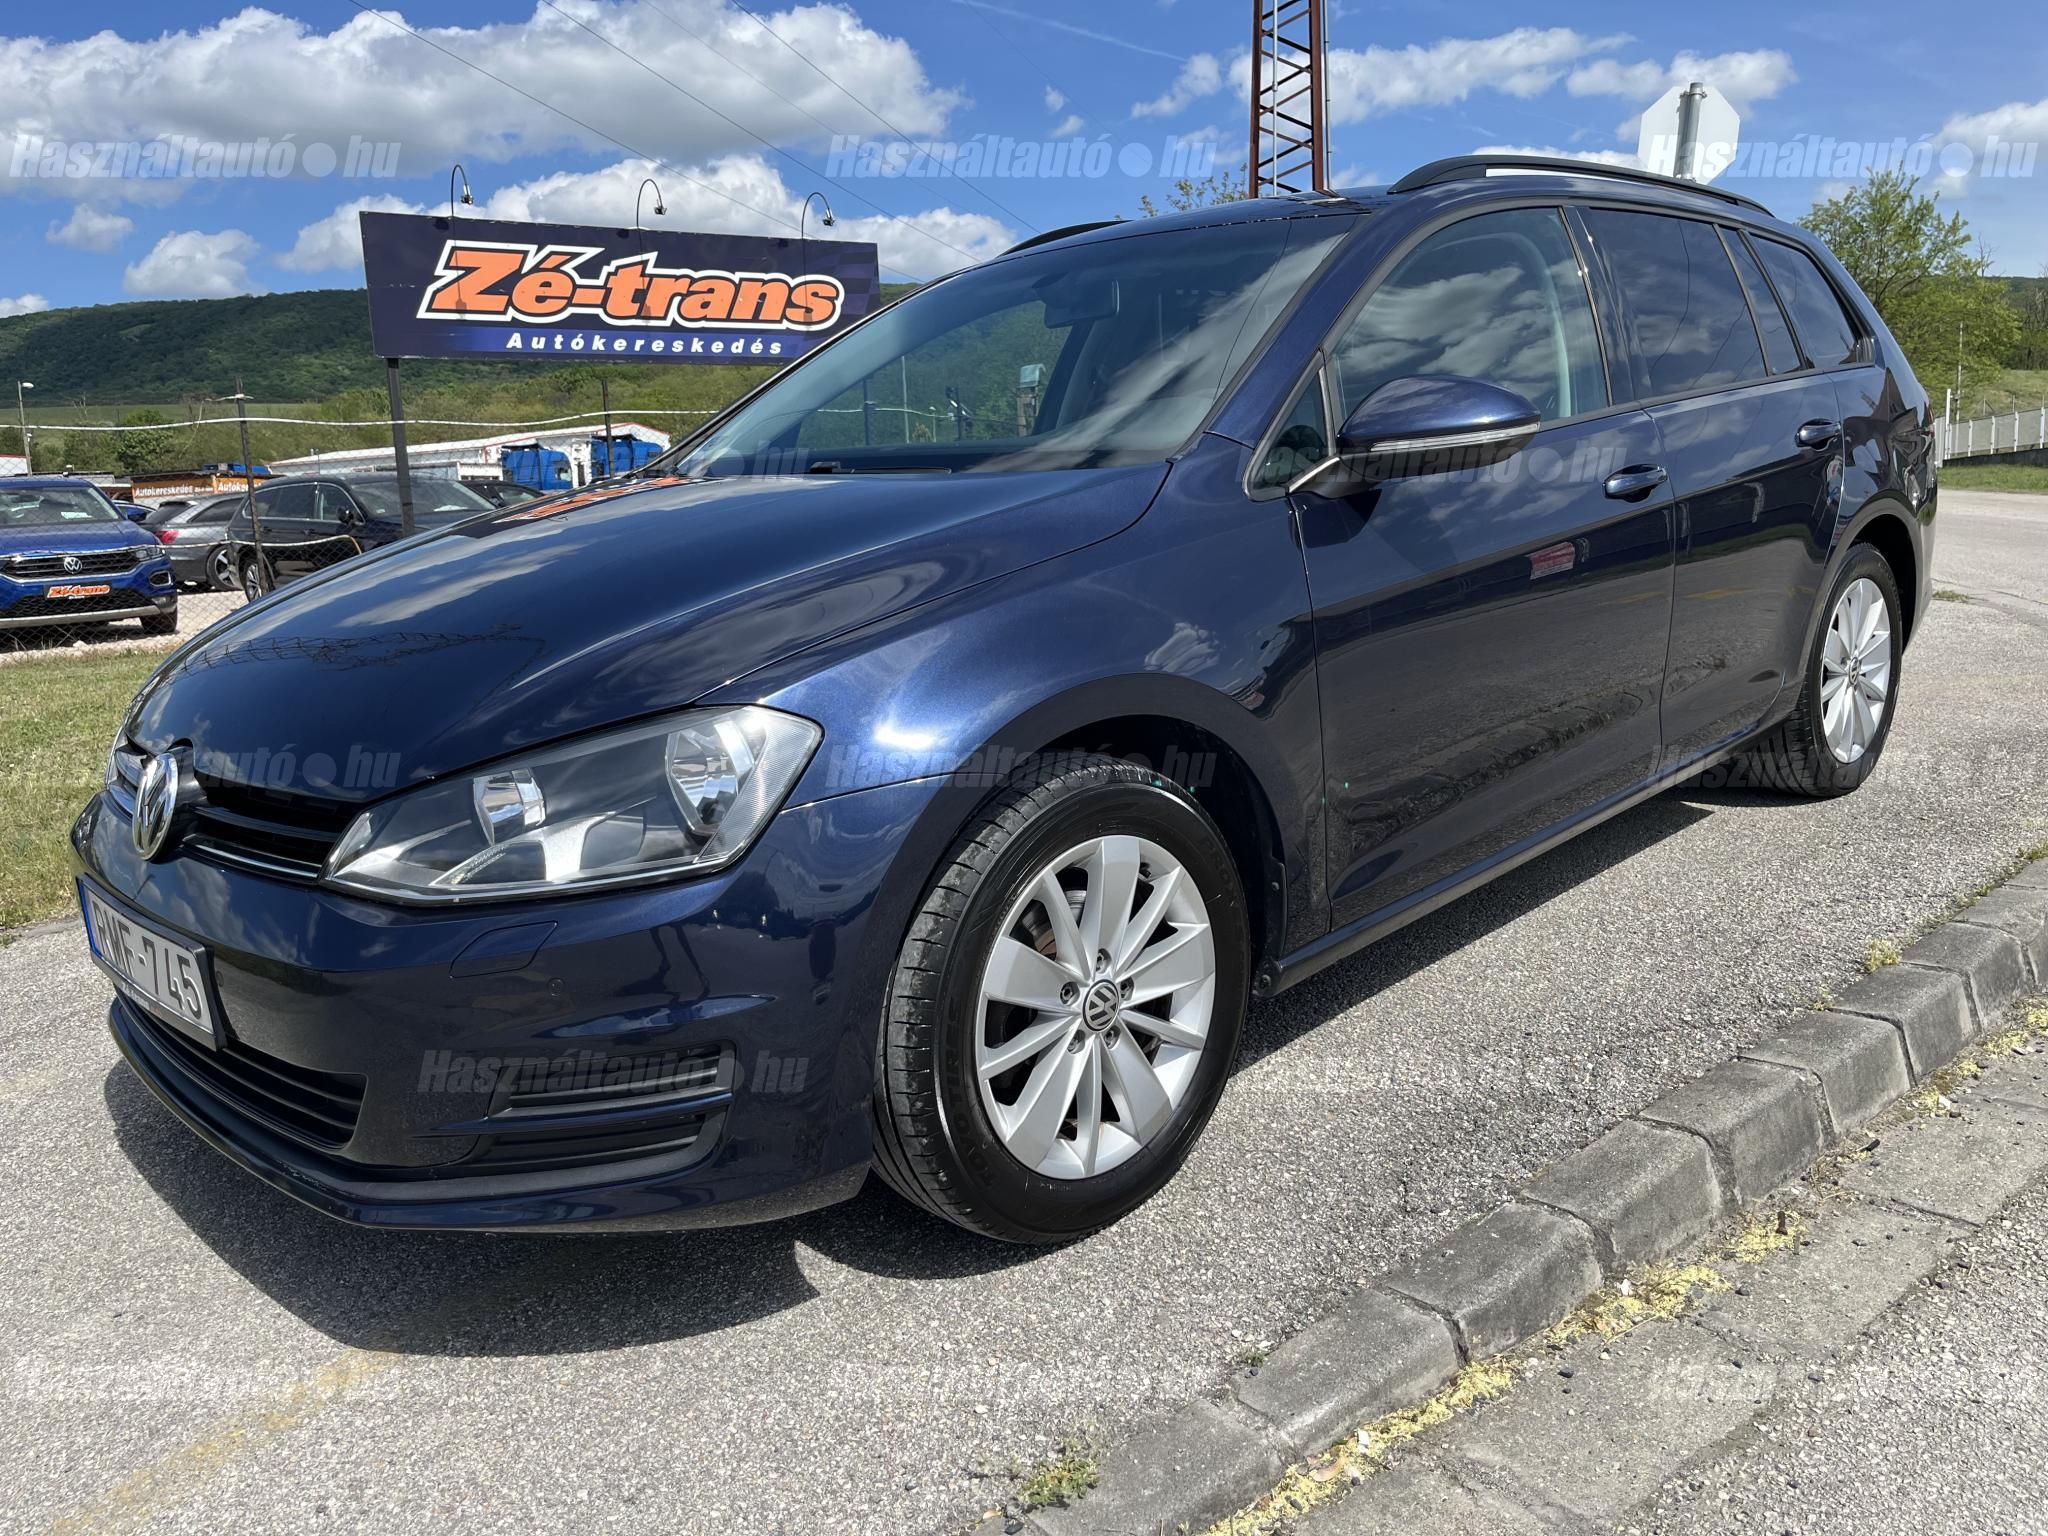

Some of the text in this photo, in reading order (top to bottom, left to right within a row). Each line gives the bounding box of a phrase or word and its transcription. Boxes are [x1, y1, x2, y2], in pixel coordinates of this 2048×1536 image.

[422, 246, 842, 326] Zé-trans
[506, 329, 783, 354] Autókereskedés
[92, 900, 203, 1020] RMF-745
